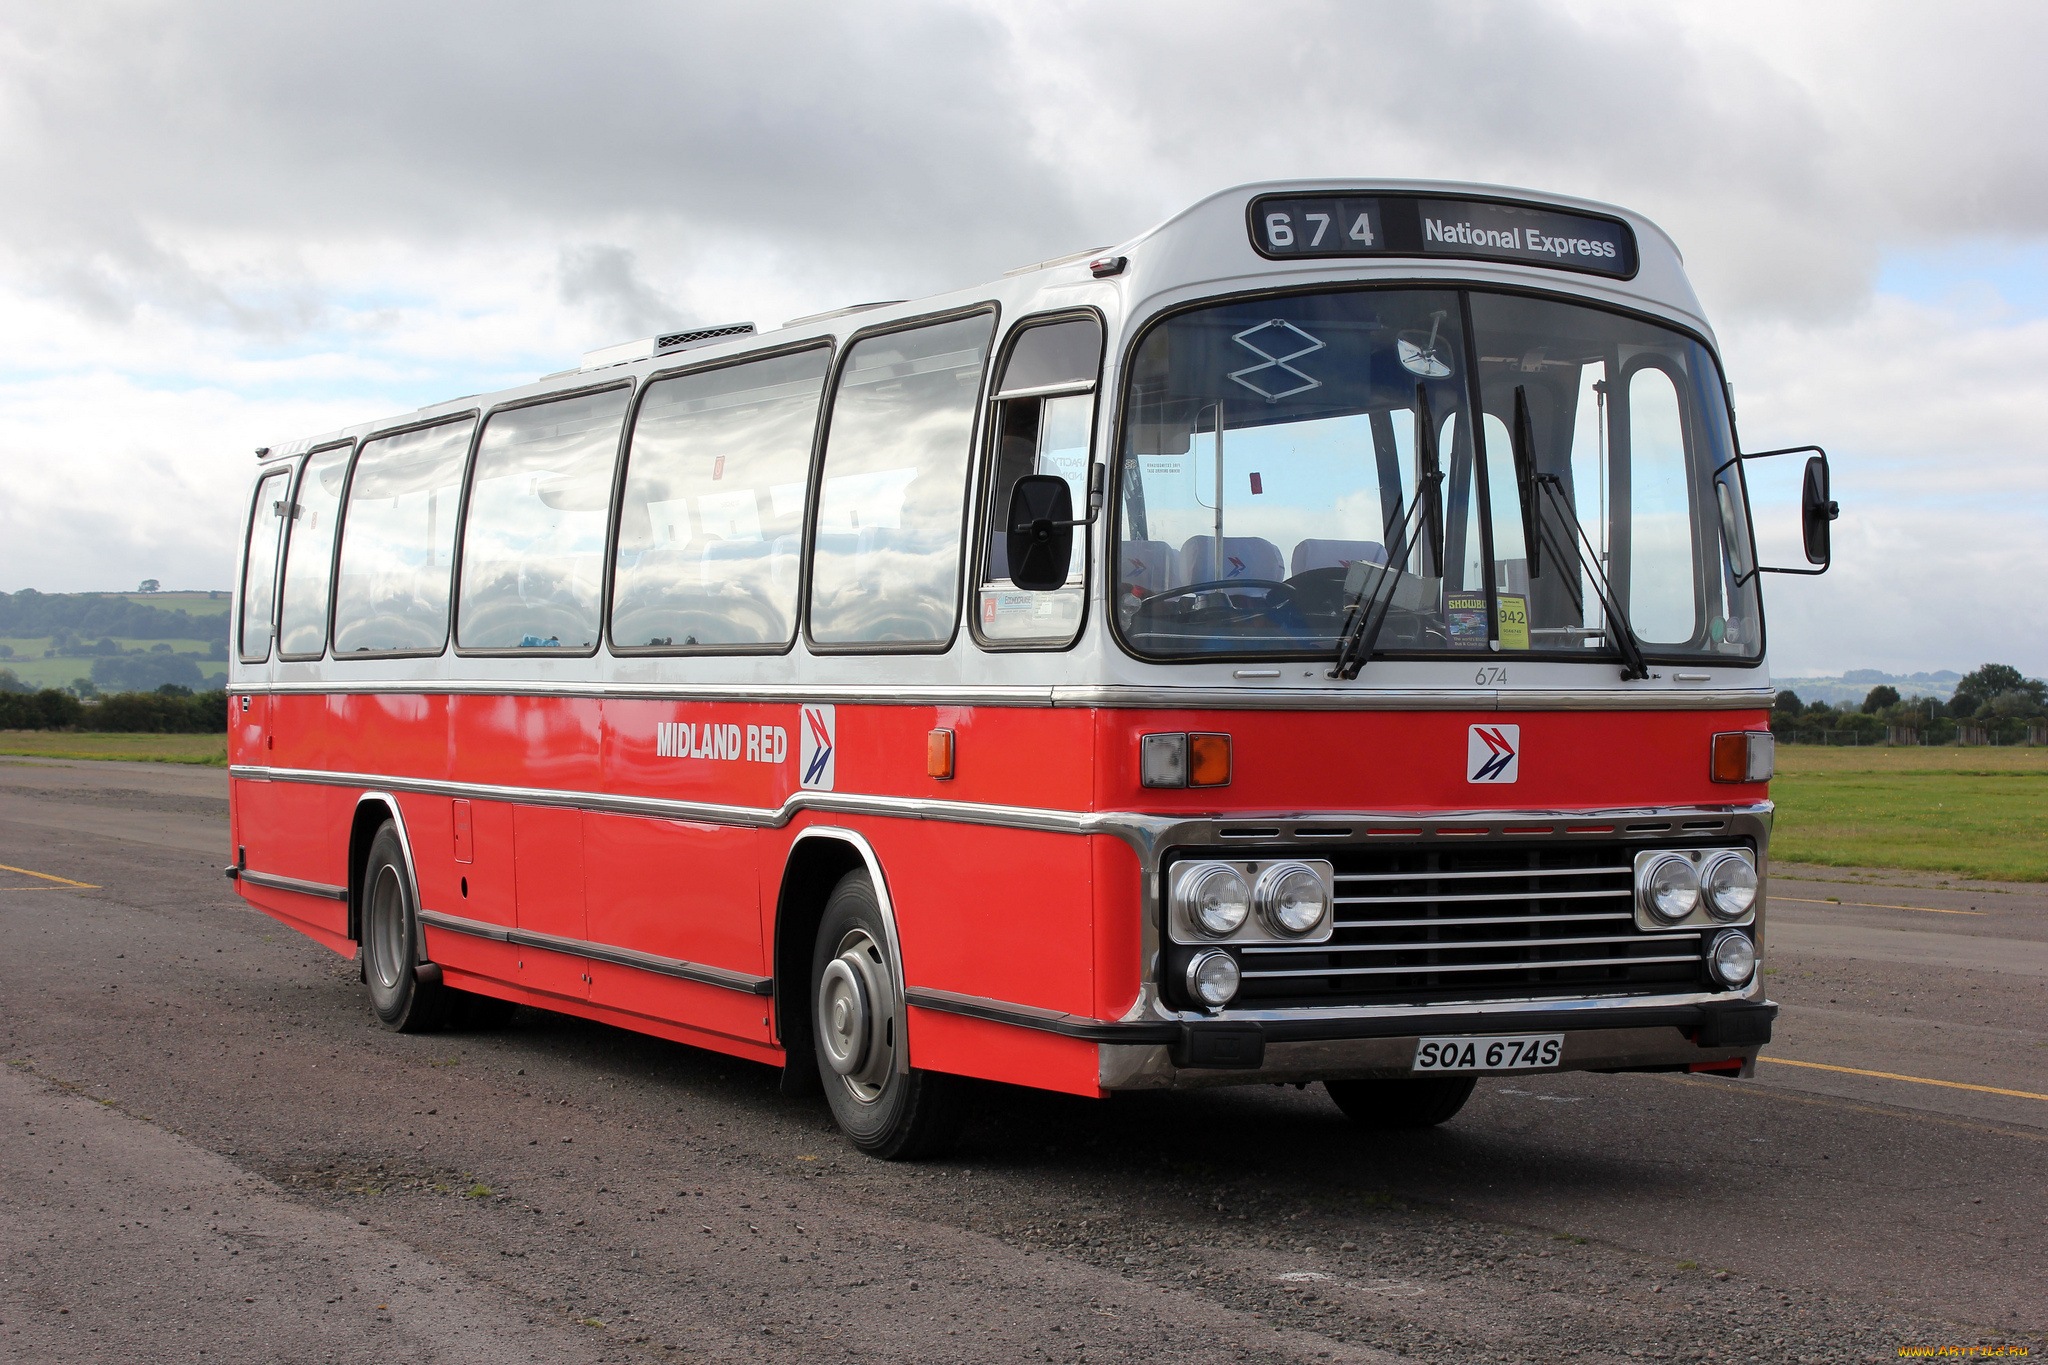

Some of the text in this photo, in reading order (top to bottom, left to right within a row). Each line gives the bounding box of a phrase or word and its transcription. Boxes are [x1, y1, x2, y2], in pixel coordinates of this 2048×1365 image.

[1265, 212, 1375, 247] 674
[1425, 217, 1617, 258] National Express
[1448, 599, 1486, 609] SHOWBU
[1499, 610, 1525, 624] 942
[1475, 667, 1507, 685] 674
[656, 722, 788, 764] MIDLAND RED
[1419, 1039, 1559, 1068] SOA 674S
